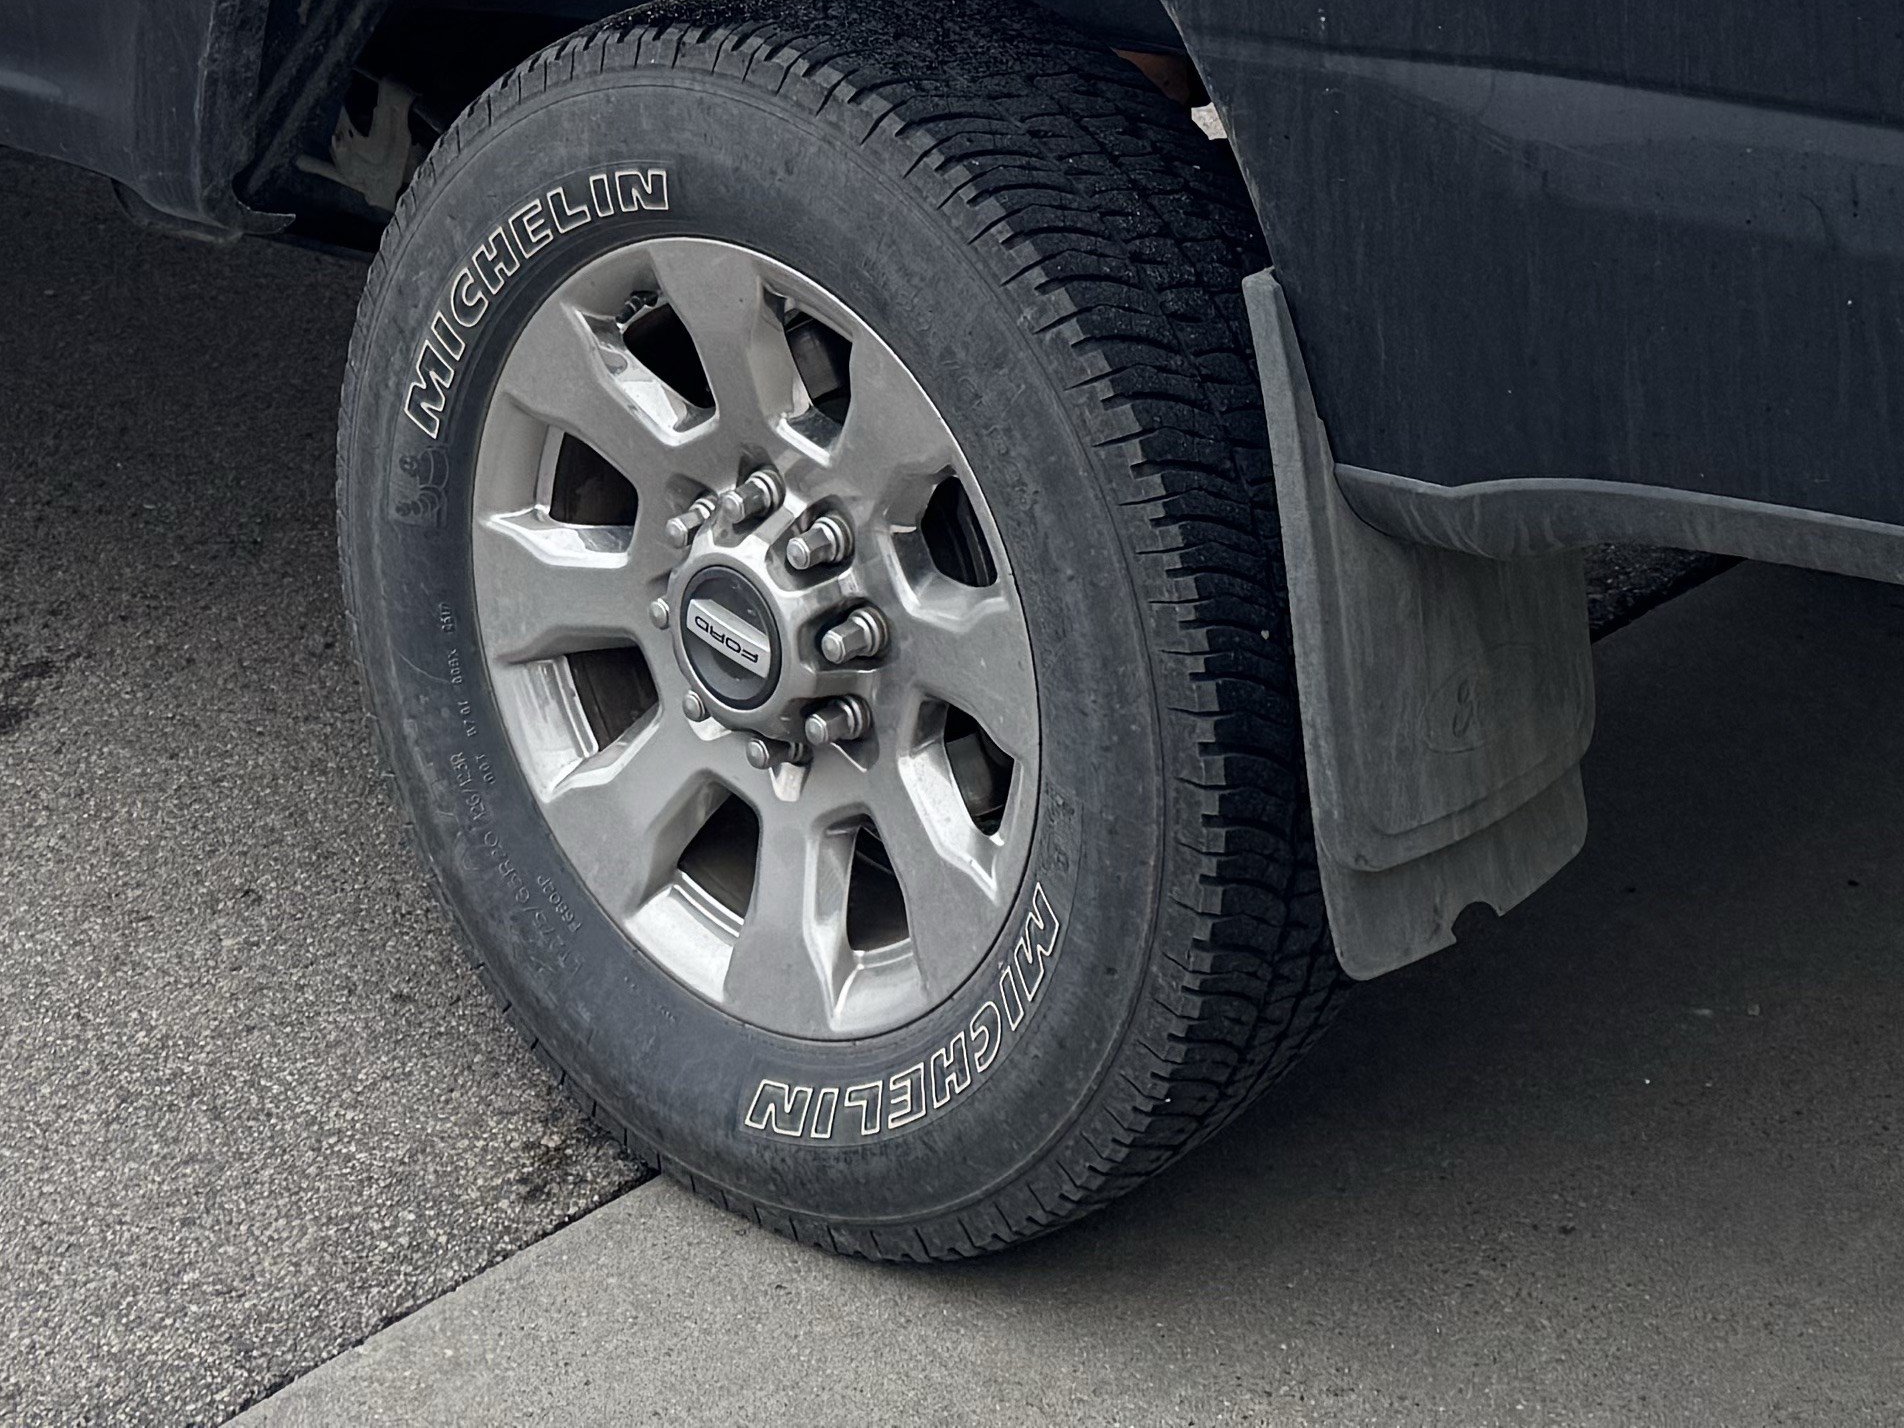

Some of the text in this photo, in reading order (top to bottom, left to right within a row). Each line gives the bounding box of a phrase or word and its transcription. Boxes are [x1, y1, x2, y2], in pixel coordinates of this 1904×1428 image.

[403, 167, 670, 440] MICHELIN
[694, 615, 759, 664] FORD
[744, 881, 1060, 1139] MICHELIN
